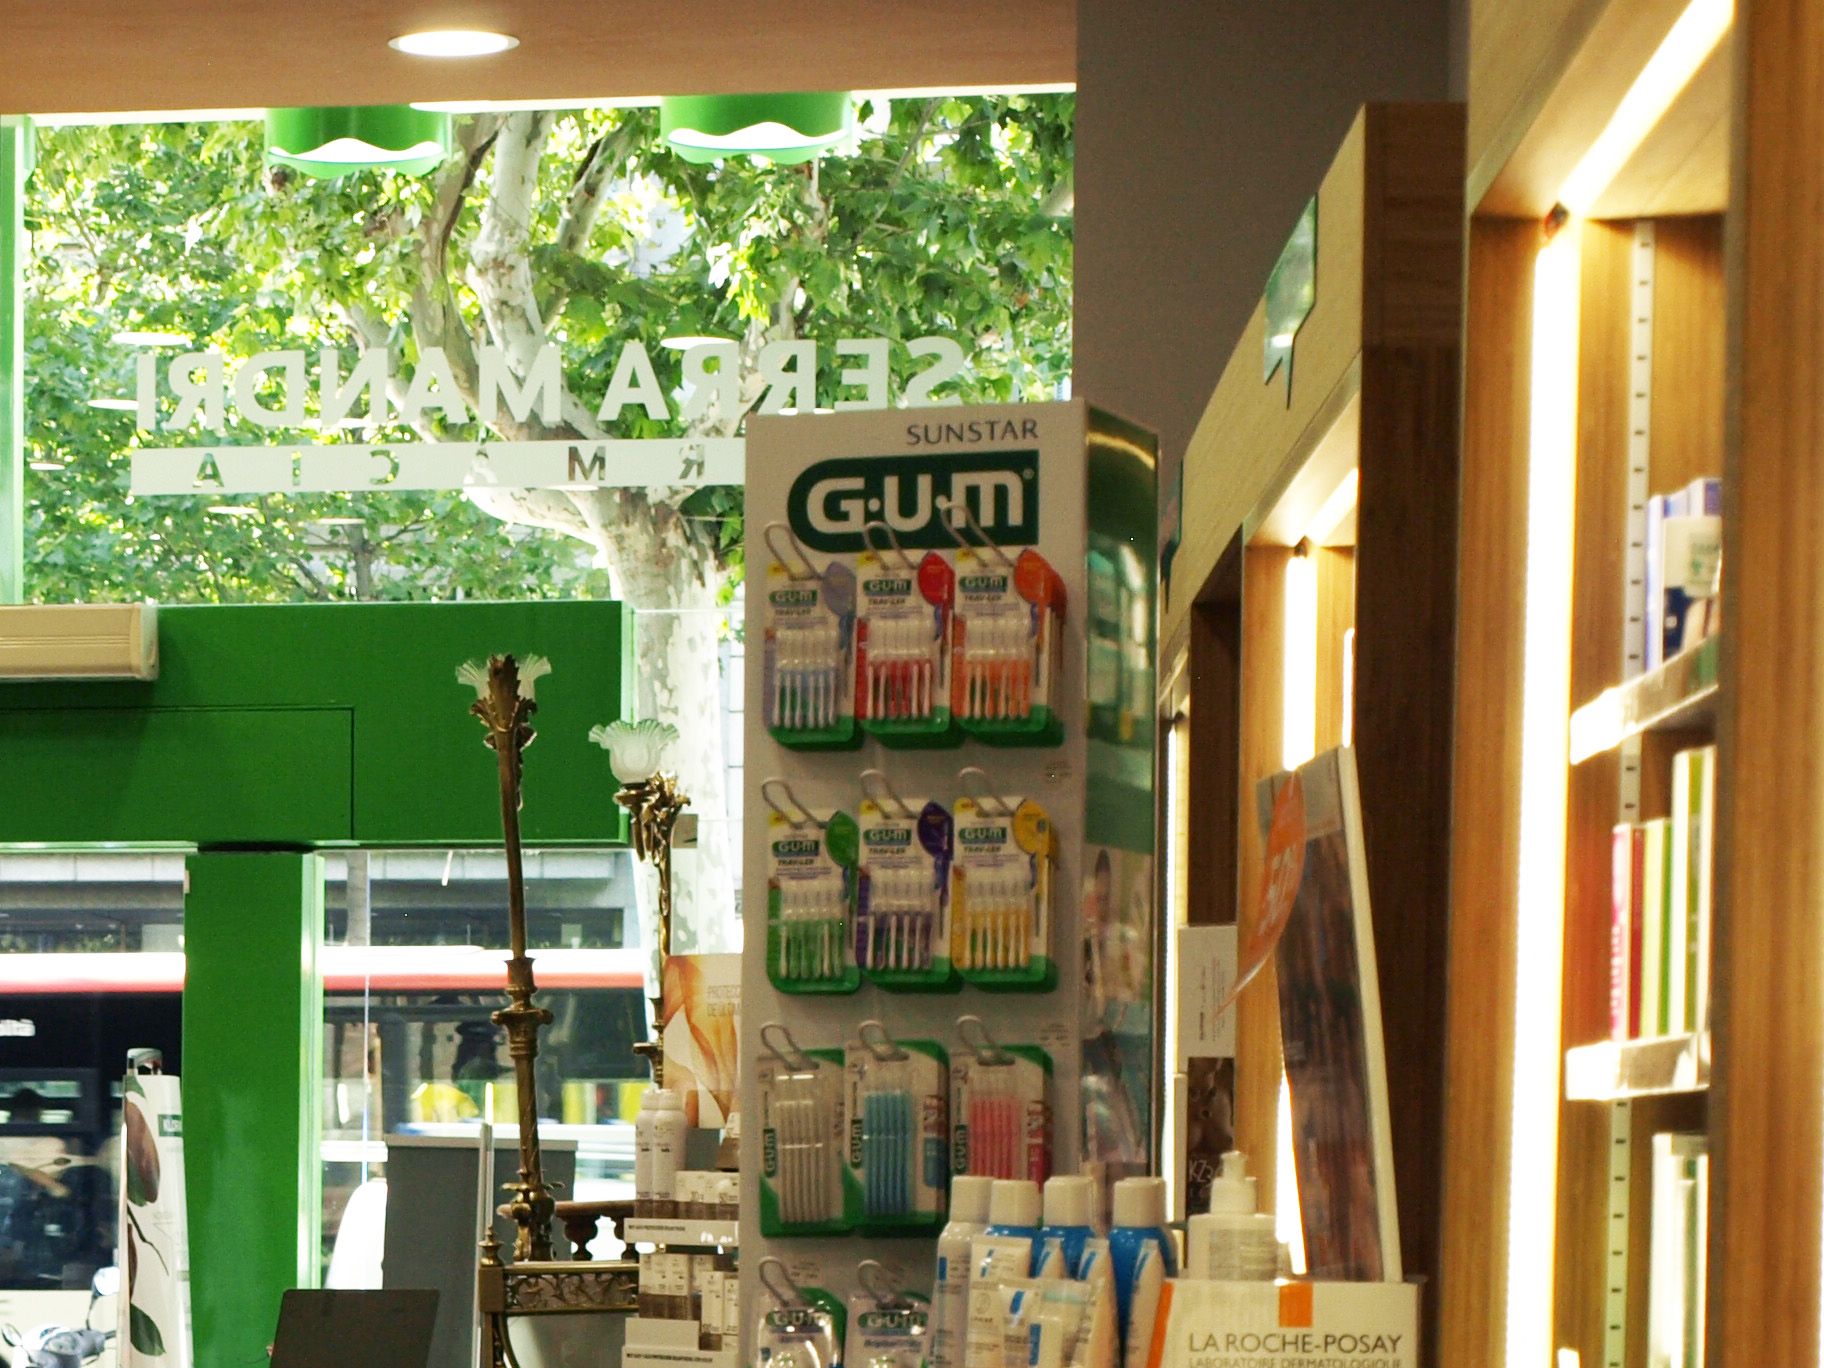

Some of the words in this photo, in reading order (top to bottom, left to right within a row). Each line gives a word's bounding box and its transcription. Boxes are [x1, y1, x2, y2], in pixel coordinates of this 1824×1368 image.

[907, 419, 1038, 445] SUNSTAR
[1189, 1333, 1219, 1352] LA
[1226, 1333, 1402, 1354] ROCHE-POSAY
